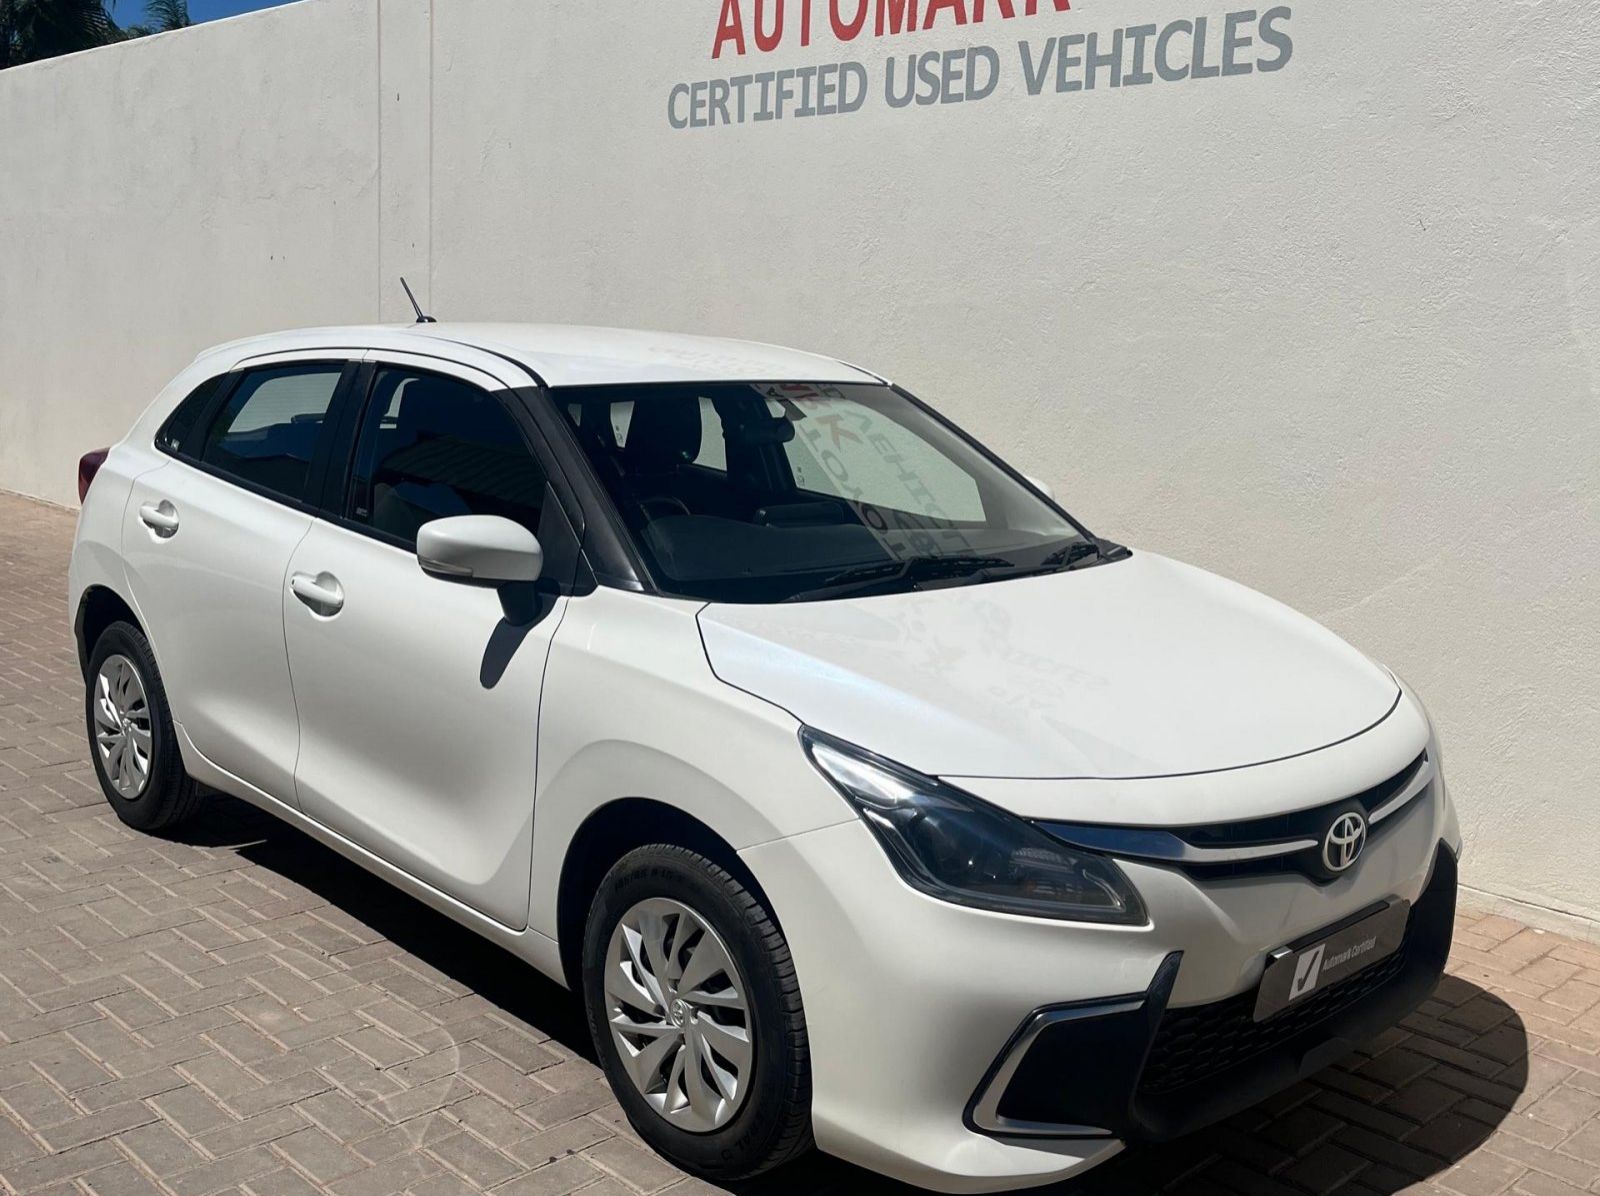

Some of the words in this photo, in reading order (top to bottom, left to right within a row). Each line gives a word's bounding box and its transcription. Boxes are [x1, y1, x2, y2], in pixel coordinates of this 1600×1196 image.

[667, 62, 868, 130] CERTIFIED
[884, 46, 1000, 109] USED
[1018, 6, 1294, 96] VEHICLES
[713, 0, 1070, 58] AUTO
